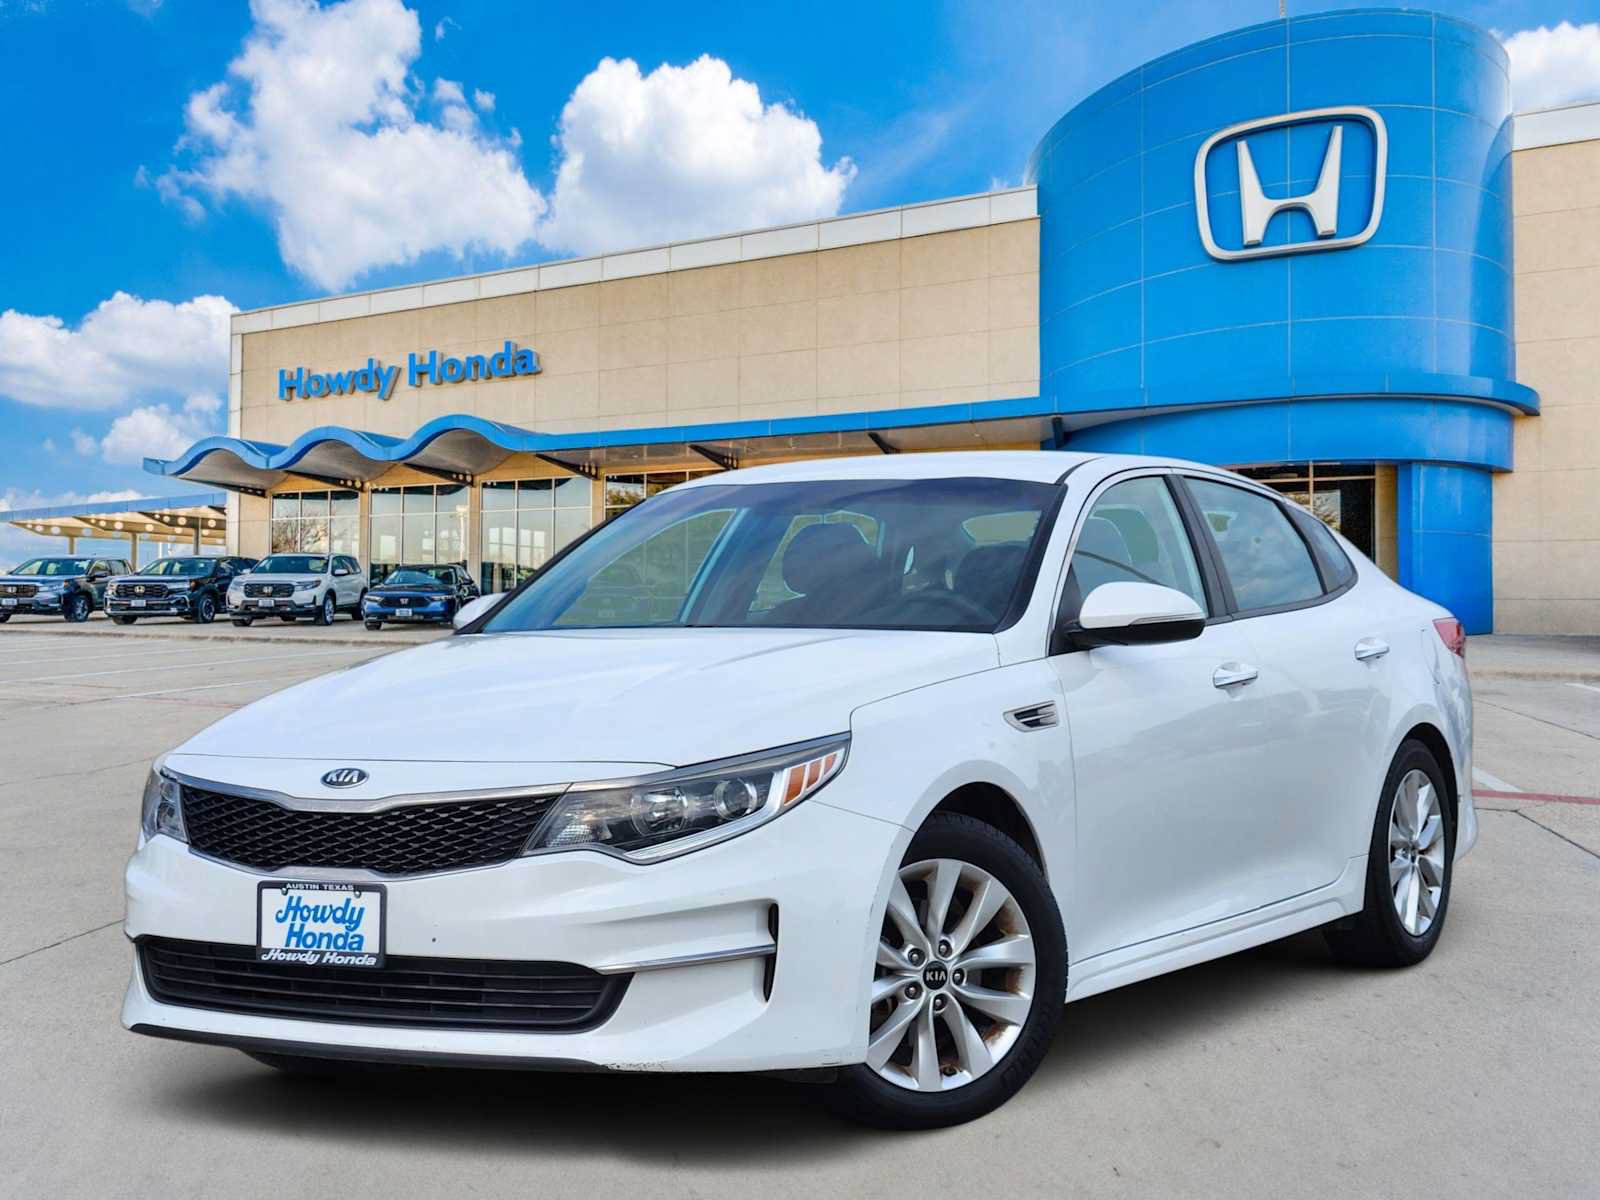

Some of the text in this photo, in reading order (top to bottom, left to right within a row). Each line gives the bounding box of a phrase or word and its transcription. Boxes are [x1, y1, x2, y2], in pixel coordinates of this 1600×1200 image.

[278, 340, 541, 401] Howdy Honda
[326, 769, 360, 783] KIA
[286, 883, 320, 891] AUSTIN
[275, 896, 365, 932] Howdy
[285, 923, 364, 951] Honda
[261, 949, 377, 966] Howdy Honda
[926, 971, 946, 981] KIA
